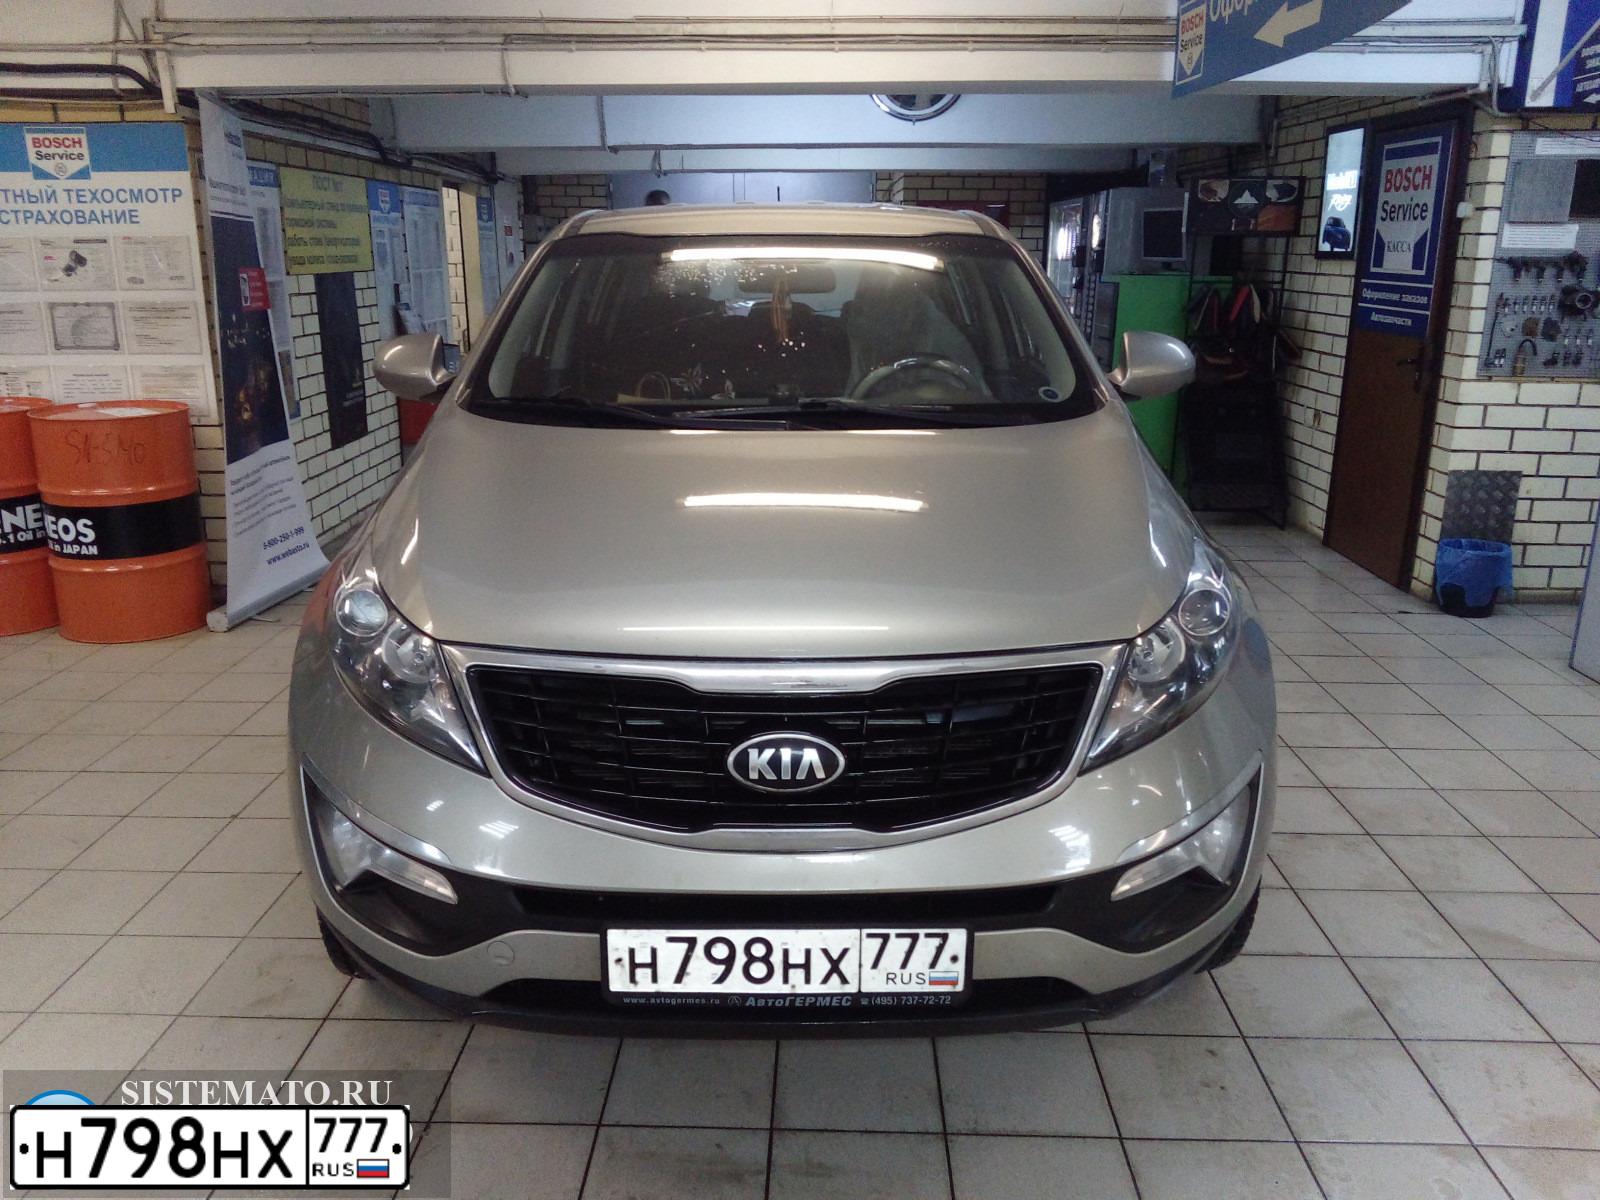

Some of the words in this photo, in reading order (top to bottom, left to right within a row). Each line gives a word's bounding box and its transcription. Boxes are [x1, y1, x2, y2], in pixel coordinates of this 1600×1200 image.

[1181, 12, 1204, 35] BOSCH
[1180, 34, 1203, 53] Service
[31, 137, 83, 149] BOSCH
[35, 150, 85, 161] Service
[1383, 165, 1433, 193] BOSCH
[64, 188, 183, 204] ТЕХОСМОТР
[0, 209, 140, 225] СТРАХОВАНИЕ
[1380, 197, 1429, 223] Service
[1386, 240, 1412, 253] КАССА
[0, 503, 43, 534] NE
[17, 530, 33, 541] Oil
[63, 544, 98, 555] JAPAN
[747, 748, 827, 780] KIA
[866, 933, 950, 970] 777
[885, 972, 927, 985] RUS
[745, 996, 852, 1007] АвтоГЕРМЕС
[871, 996, 897, 1006] (495)
[901, 995, 951, 1005] 737-72-72
